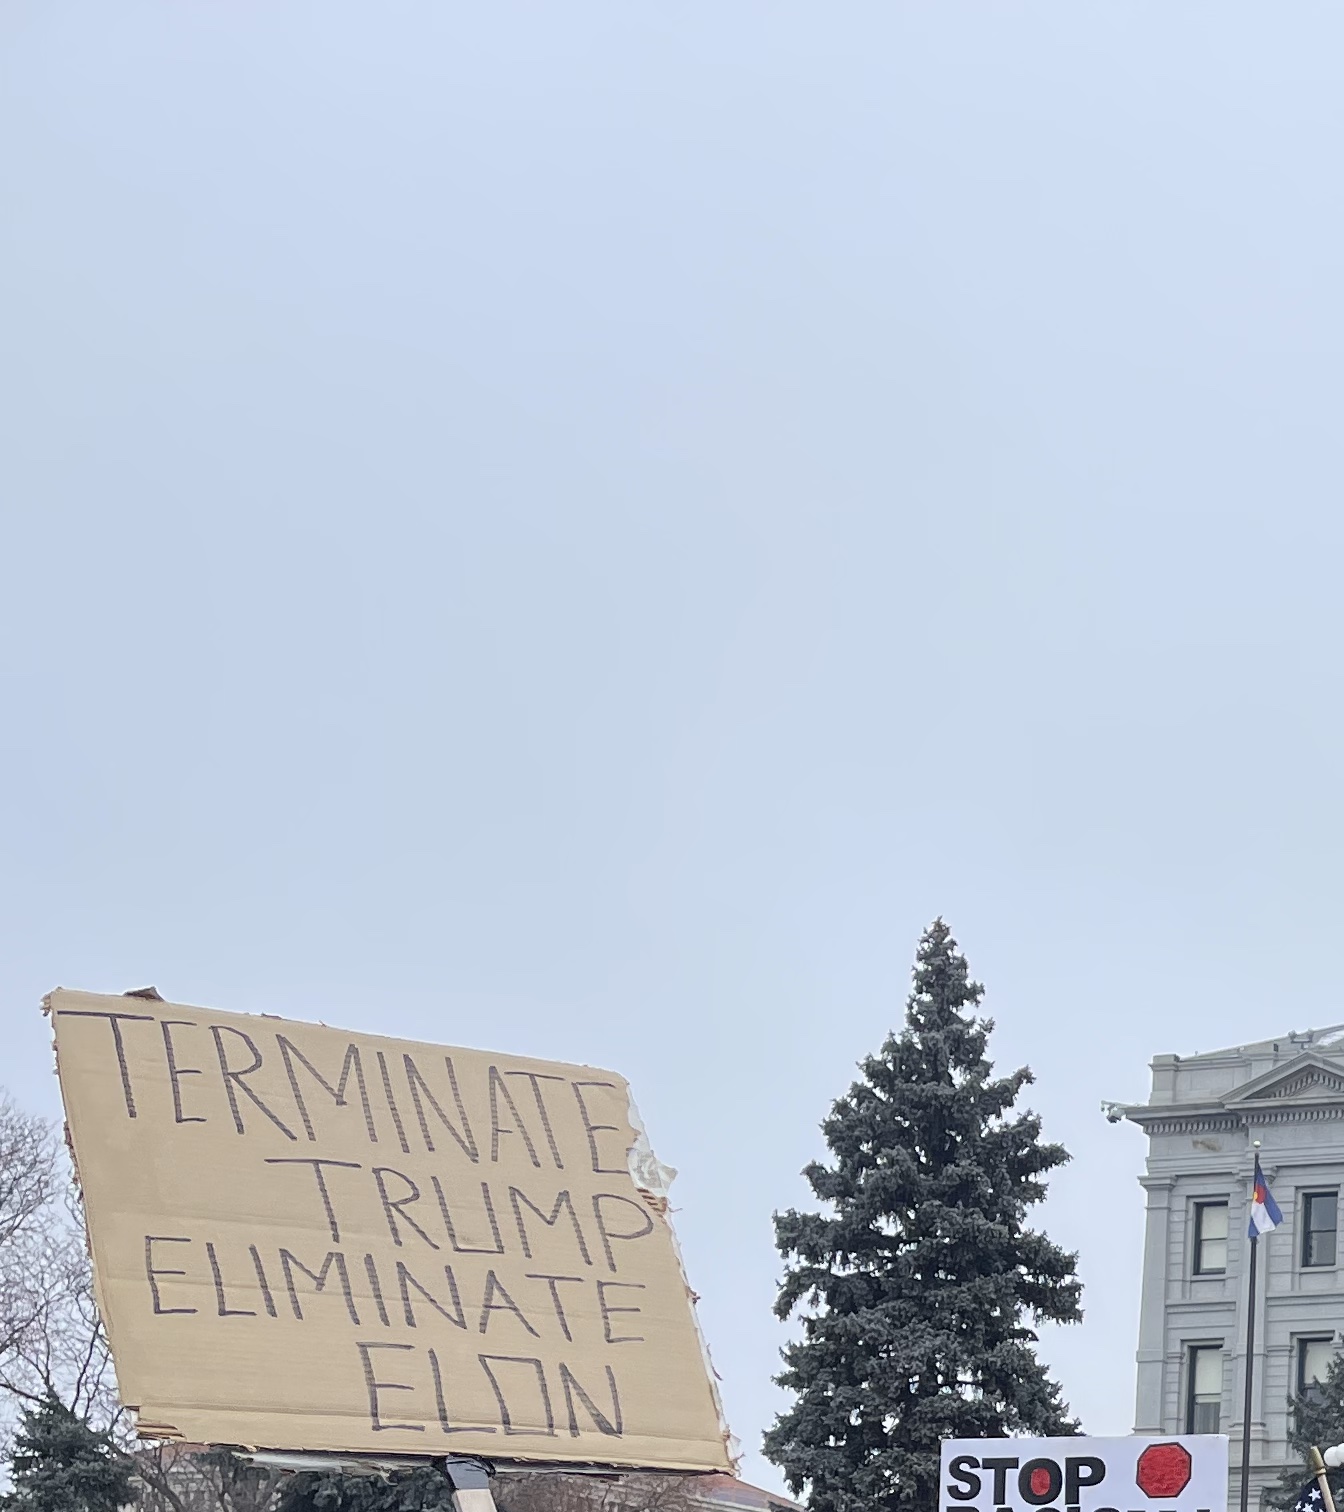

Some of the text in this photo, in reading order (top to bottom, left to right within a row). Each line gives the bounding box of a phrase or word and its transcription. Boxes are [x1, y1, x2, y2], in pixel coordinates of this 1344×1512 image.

[57, 1010, 631, 1175] TERMINATE
[264, 1158, 654, 1273] TRUMP
[144, 1235, 647, 1344] ELIMINATE
[356, 1341, 623, 1439] ELON
[946, 1455, 1106, 1506] STOP
